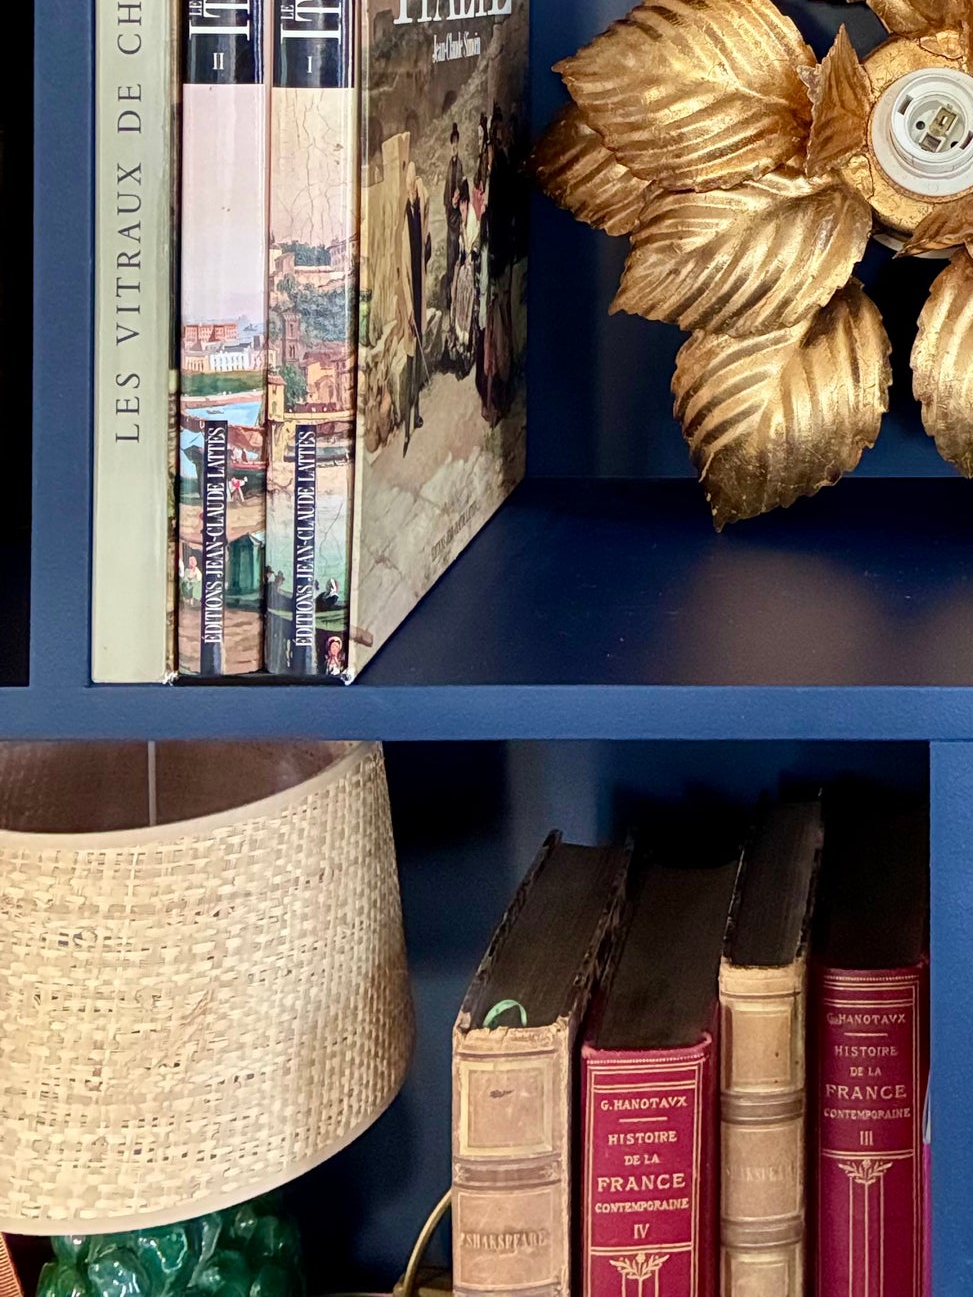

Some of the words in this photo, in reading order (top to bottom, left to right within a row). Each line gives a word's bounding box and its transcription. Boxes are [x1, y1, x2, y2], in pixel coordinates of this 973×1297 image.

[189, 0, 202, 17] LE
[280, 4, 295, 20] LE
[212, 52, 225, 70] II
[117, 83, 142, 134] DE
[116, 162, 142, 346] VITRAUX
[115, 372, 141, 443] LES
[206, 427, 226, 478] LATTÈS
[296, 431, 316, 482] LATTÈS
[206, 480, 225, 579] JEAN-CLAUDE
[296, 486, 315, 583] JEAN-CLAUDE
[202, 582, 224, 644] ÉDITIONS
[294, 586, 314, 647] ÉDITIONS
[835, 1045, 898, 1057] HISTOIRE
[850, 1066, 864, 1077] DE
[868, 1067, 882, 1077] LA
[825, 1084, 907, 1100] FRANCE
[824, 1108, 911, 1120] CONTEMPORAINE
[608, 1131, 678, 1146] HISTOIRE
[860, 1131, 873, 1146] III
[624, 1155, 641, 1166] DE
[644, 1154, 660, 1165] LA
[597, 1173, 686, 1192] FRANCE
[595, 1198, 689, 1214] CONTEMPORAINE
[633, 1223, 650, 1239] IV
